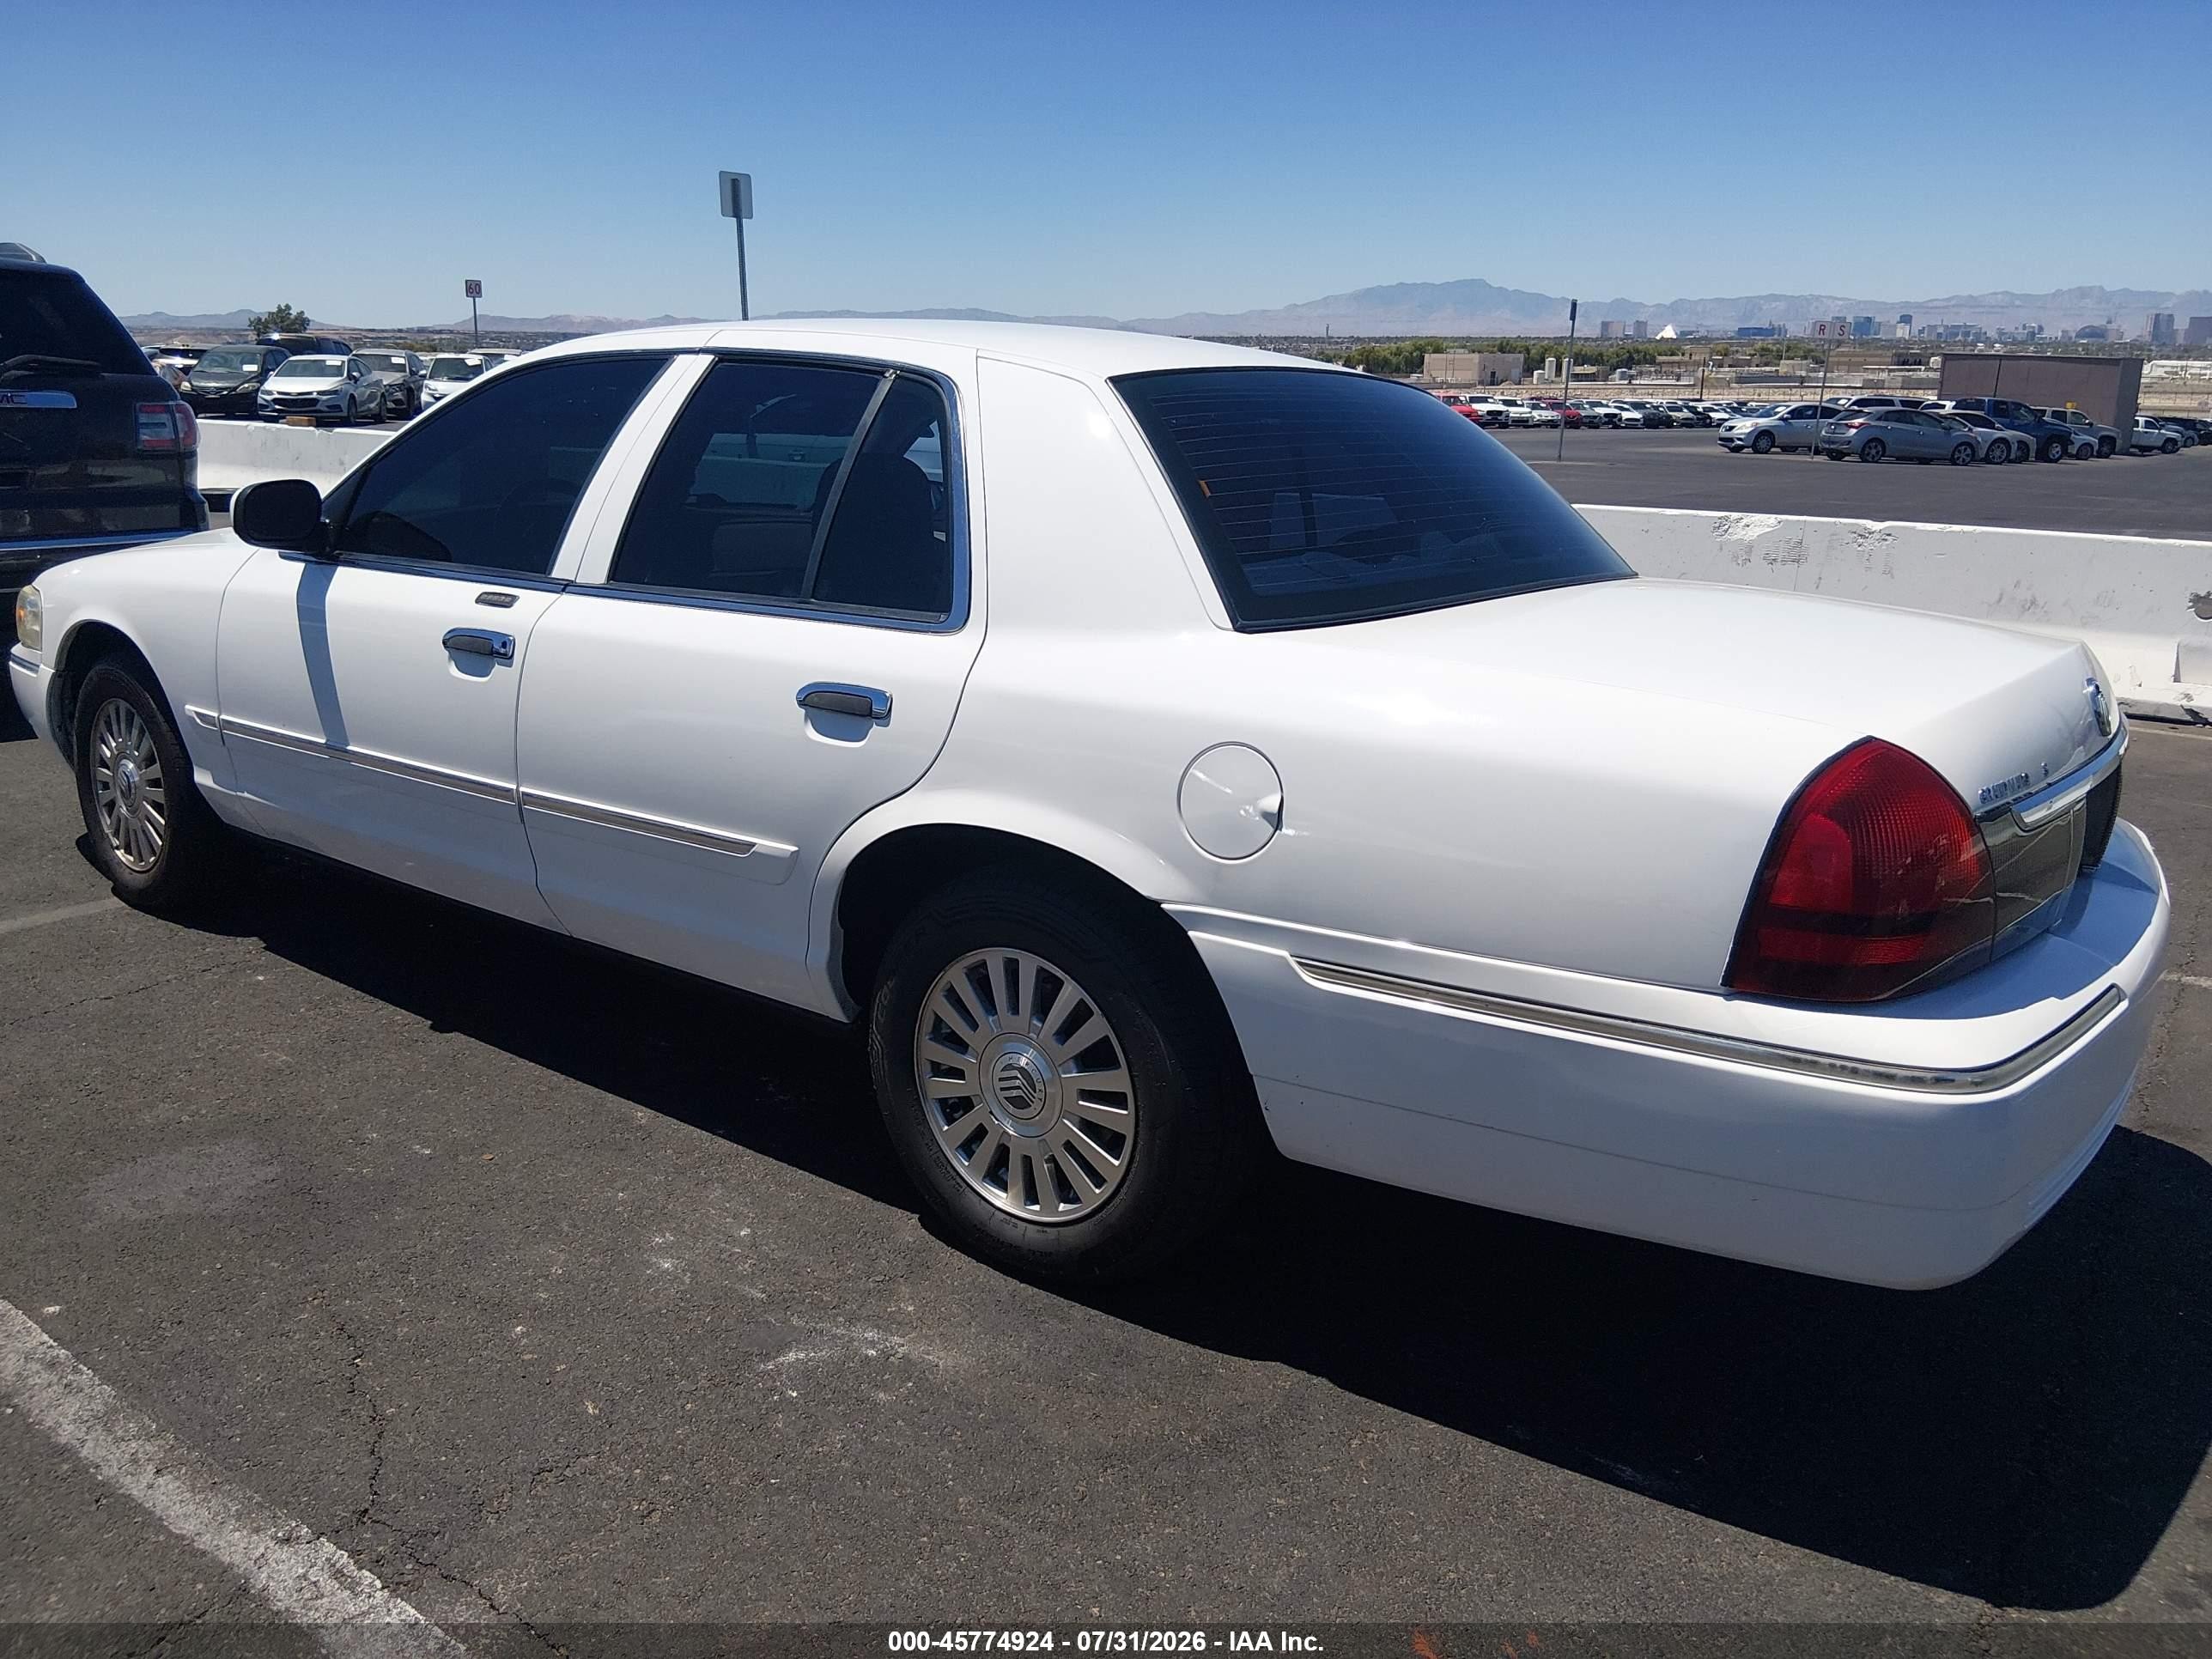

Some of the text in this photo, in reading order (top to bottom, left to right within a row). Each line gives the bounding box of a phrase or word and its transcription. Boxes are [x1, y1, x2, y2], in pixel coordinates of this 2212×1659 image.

[468, 283, 481, 295] 60
[1819, 324, 1846, 336] R S
[1008, 1056, 1043, 1102] MERCURY
